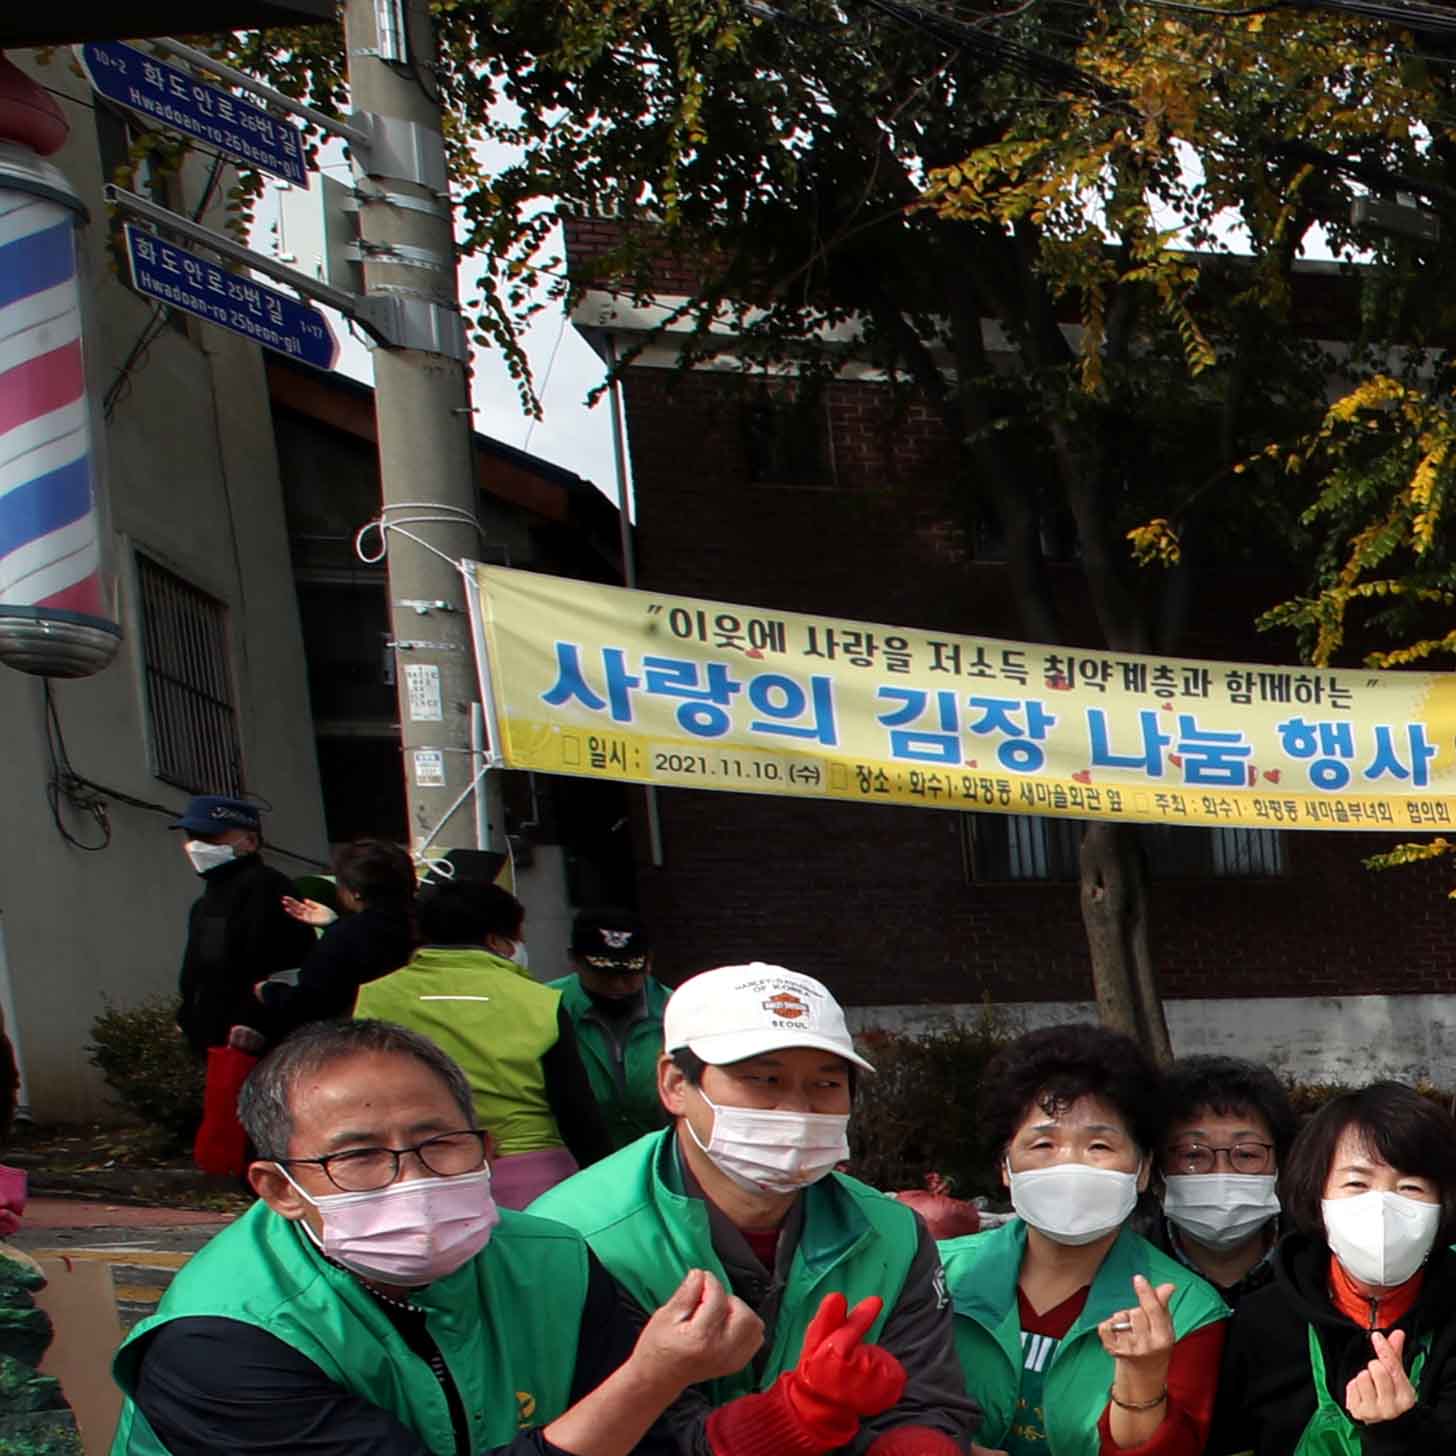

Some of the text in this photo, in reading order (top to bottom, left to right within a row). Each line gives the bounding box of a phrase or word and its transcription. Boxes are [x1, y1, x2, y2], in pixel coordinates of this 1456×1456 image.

[803, 624, 914, 675] 사랑을
[927, 639, 1028, 686] 저소득
[541, 640, 1437, 791] 사랑의 김장 나눔 행사
[587, 735, 628, 771] 일시
[855, 764, 891, 795] 장소
[1020, 783, 1102, 811] 새마을회관
[772, 1020, 809, 1030] SEOUL
